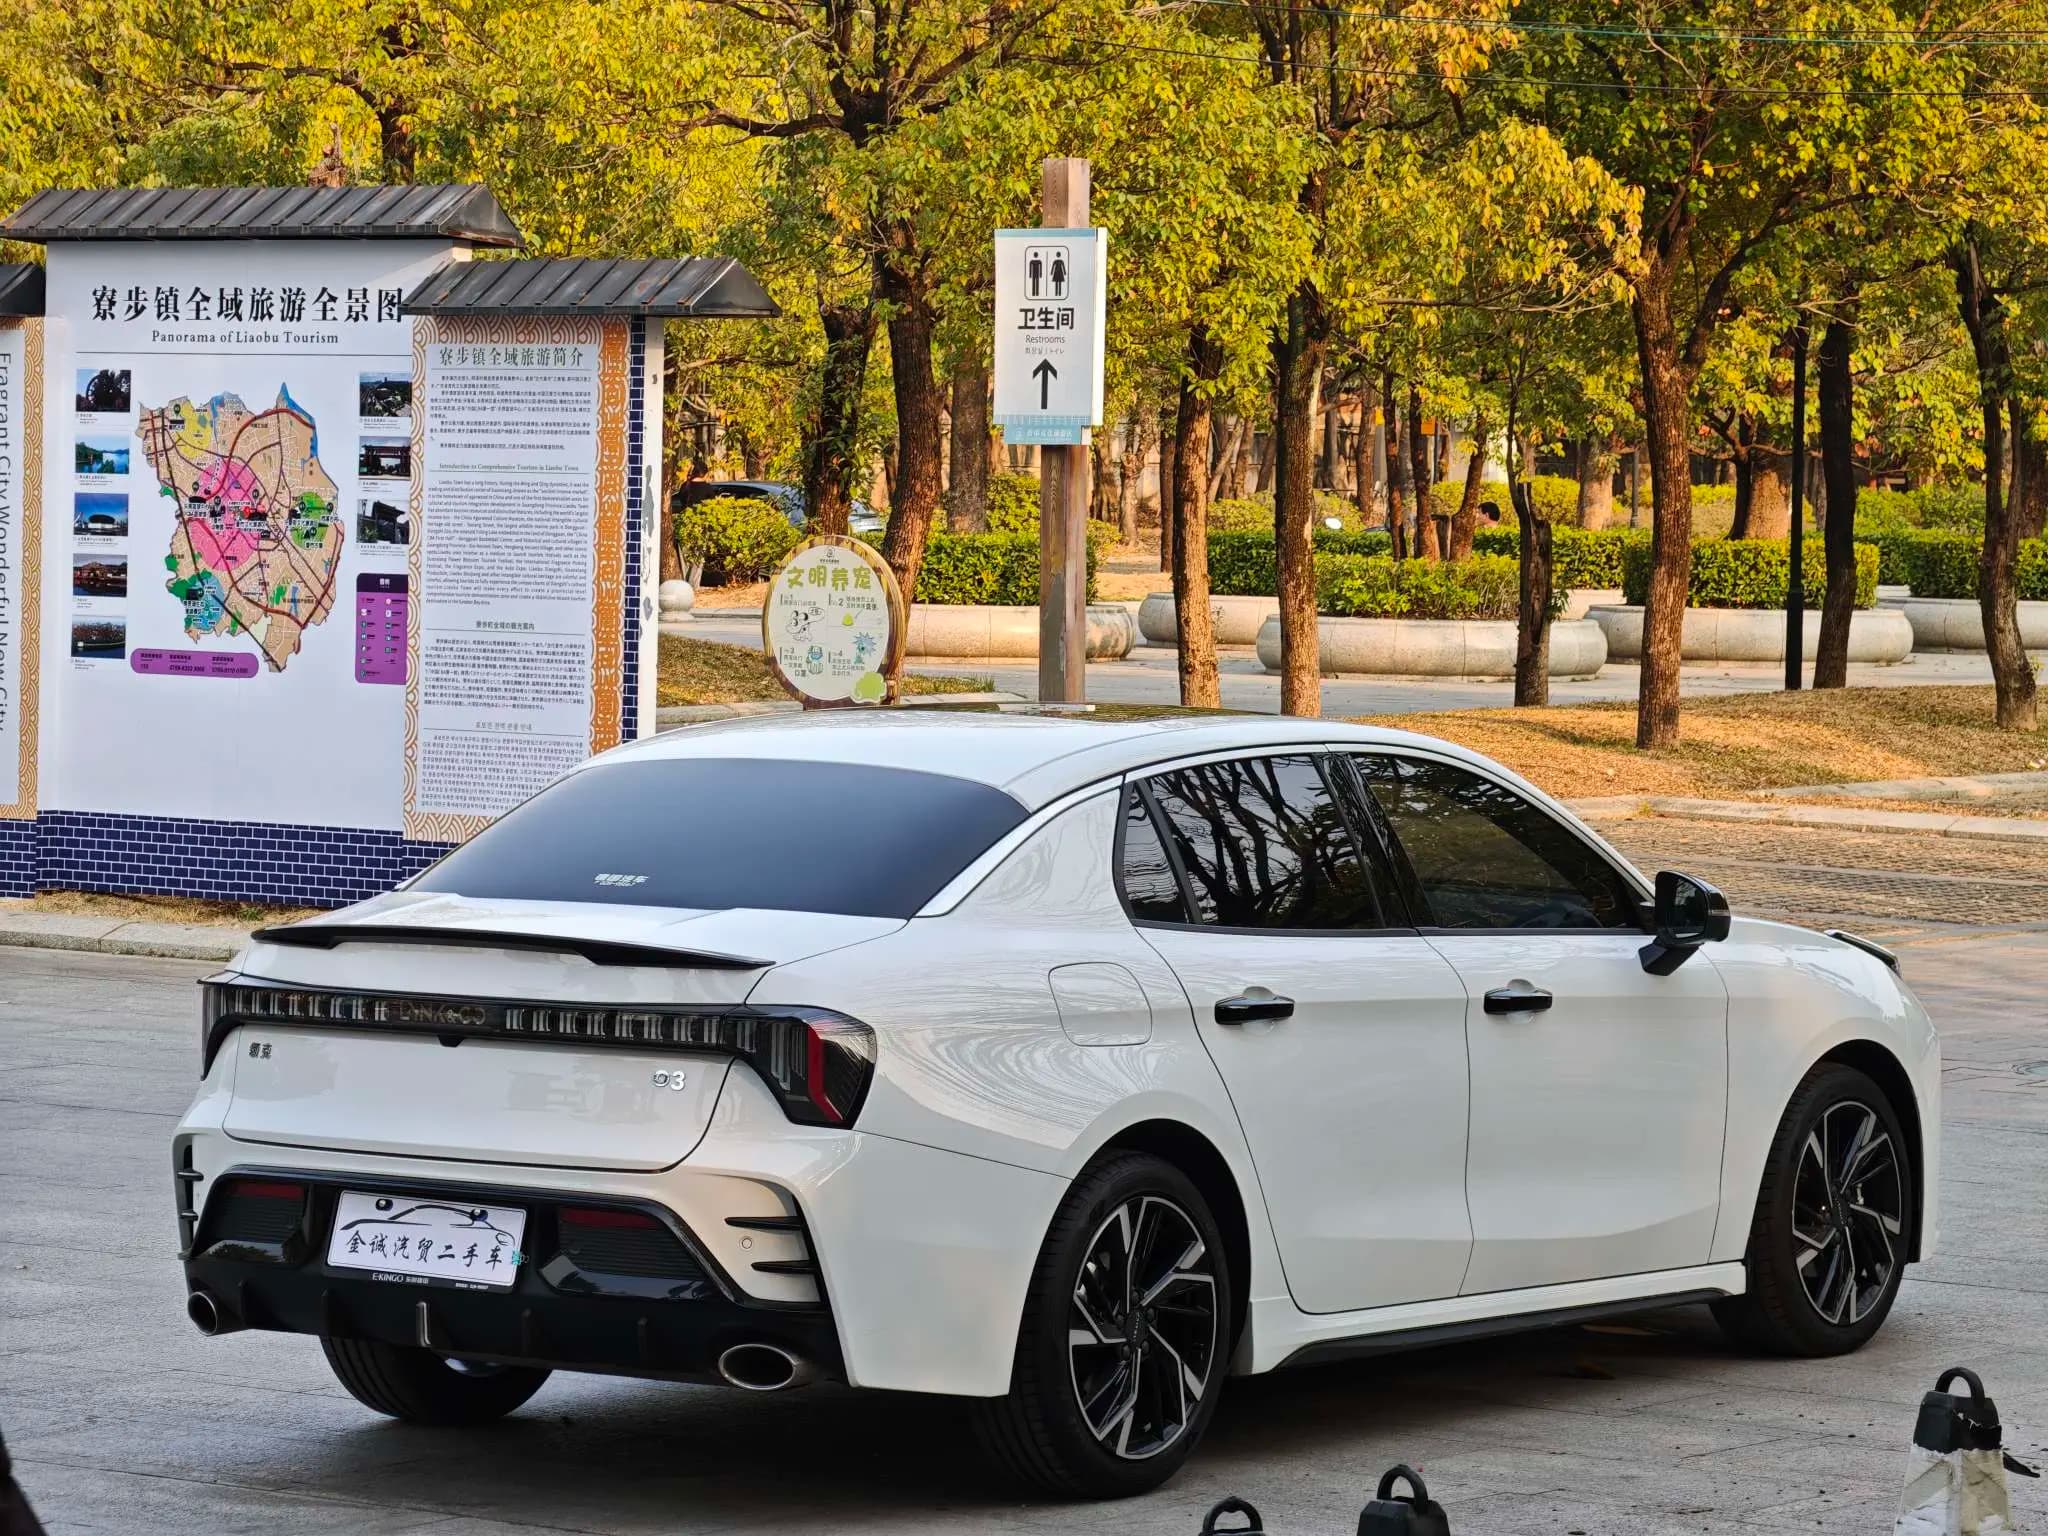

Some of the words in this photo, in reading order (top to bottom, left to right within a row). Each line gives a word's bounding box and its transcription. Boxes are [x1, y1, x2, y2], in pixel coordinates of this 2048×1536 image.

[92, 285, 403, 323] 寮步镇全域旅游全景图
[1017, 306, 1074, 330] 卫生间
[152, 330, 216, 343] Panorama
[220, 330, 235, 343] of
[236, 330, 279, 343] Liaobu
[283, 331, 338, 344] Tourism
[1025, 334, 1065, 344] Restrooms
[440, 346, 583, 366] 寮步镇全域旅游简介
[0, 354, 12, 449] Fragrant
[786, 565, 872, 592] 文明养宠
[653, 1070, 686, 1091] 03
[346, 1230, 502, 1271] 金诚汽贸二手车
